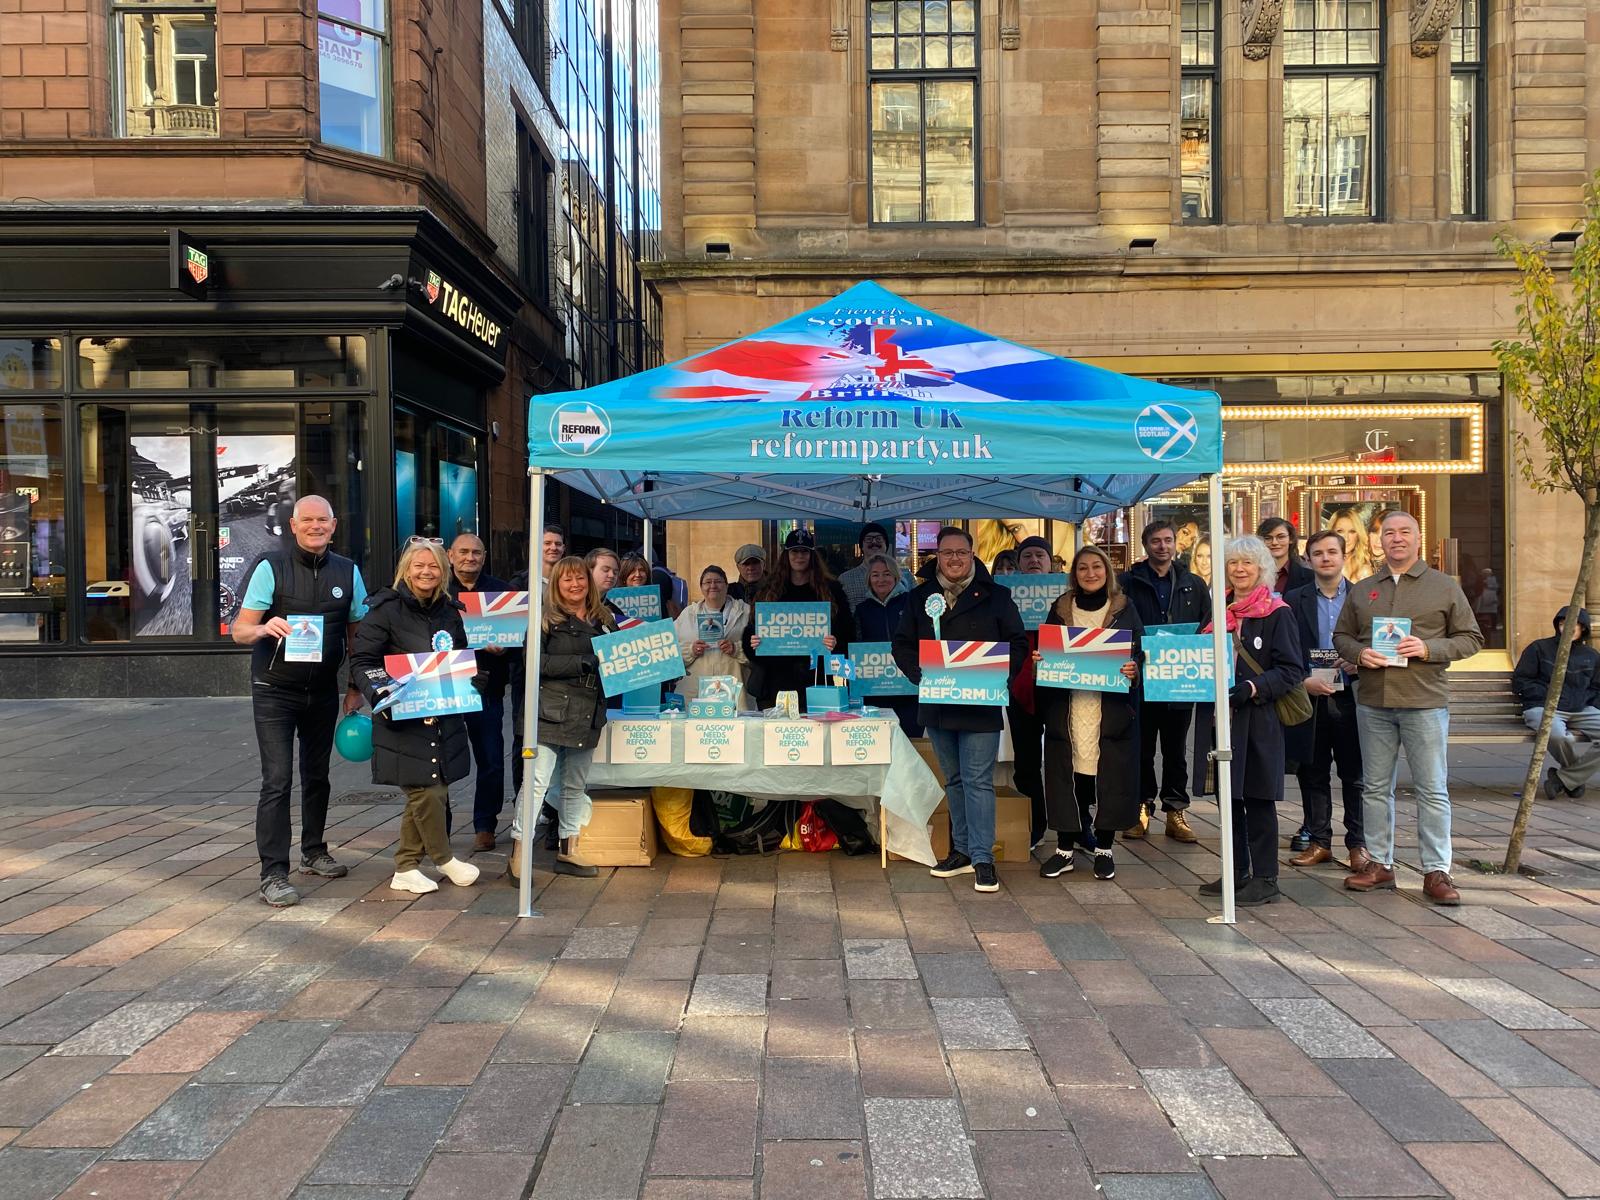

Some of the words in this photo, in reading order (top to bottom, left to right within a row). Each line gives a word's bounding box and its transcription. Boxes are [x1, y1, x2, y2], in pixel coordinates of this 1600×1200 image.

[188, 249, 206, 267] TAG
[806, 315, 934, 327] Scottish
[809, 387, 935, 399] British
[779, 405, 899, 429] Reform
[911, 405, 965, 429] UK
[561, 424, 601, 435] REFORM
[561, 434, 573, 443] UK
[749, 431, 993, 466] reformparty.uk
[611, 595, 658, 608] OINED
[757, 613, 763, 625] I
[767, 612, 828, 626] JOINED
[758, 625, 829, 638] REFORM
[609, 631, 675, 660] JOINED
[601, 643, 679, 677] REFORM
[933, 674, 957, 690] voting
[622, 724, 661, 732] GLASGOW
[695, 724, 735, 732] GLASGOW
[774, 726, 813, 734] GLASGOW
[840, 725, 880, 733] GLASGOW
[629, 731, 653, 739] NEEDS
[703, 731, 726, 739] NEEDS
[848, 732, 872, 740] NEEDS
[625, 738, 657, 746] REFORM
[699, 738, 730, 746] REFORM
[779, 739, 809, 747] REFORM
[845, 738, 876, 747] REFORM
